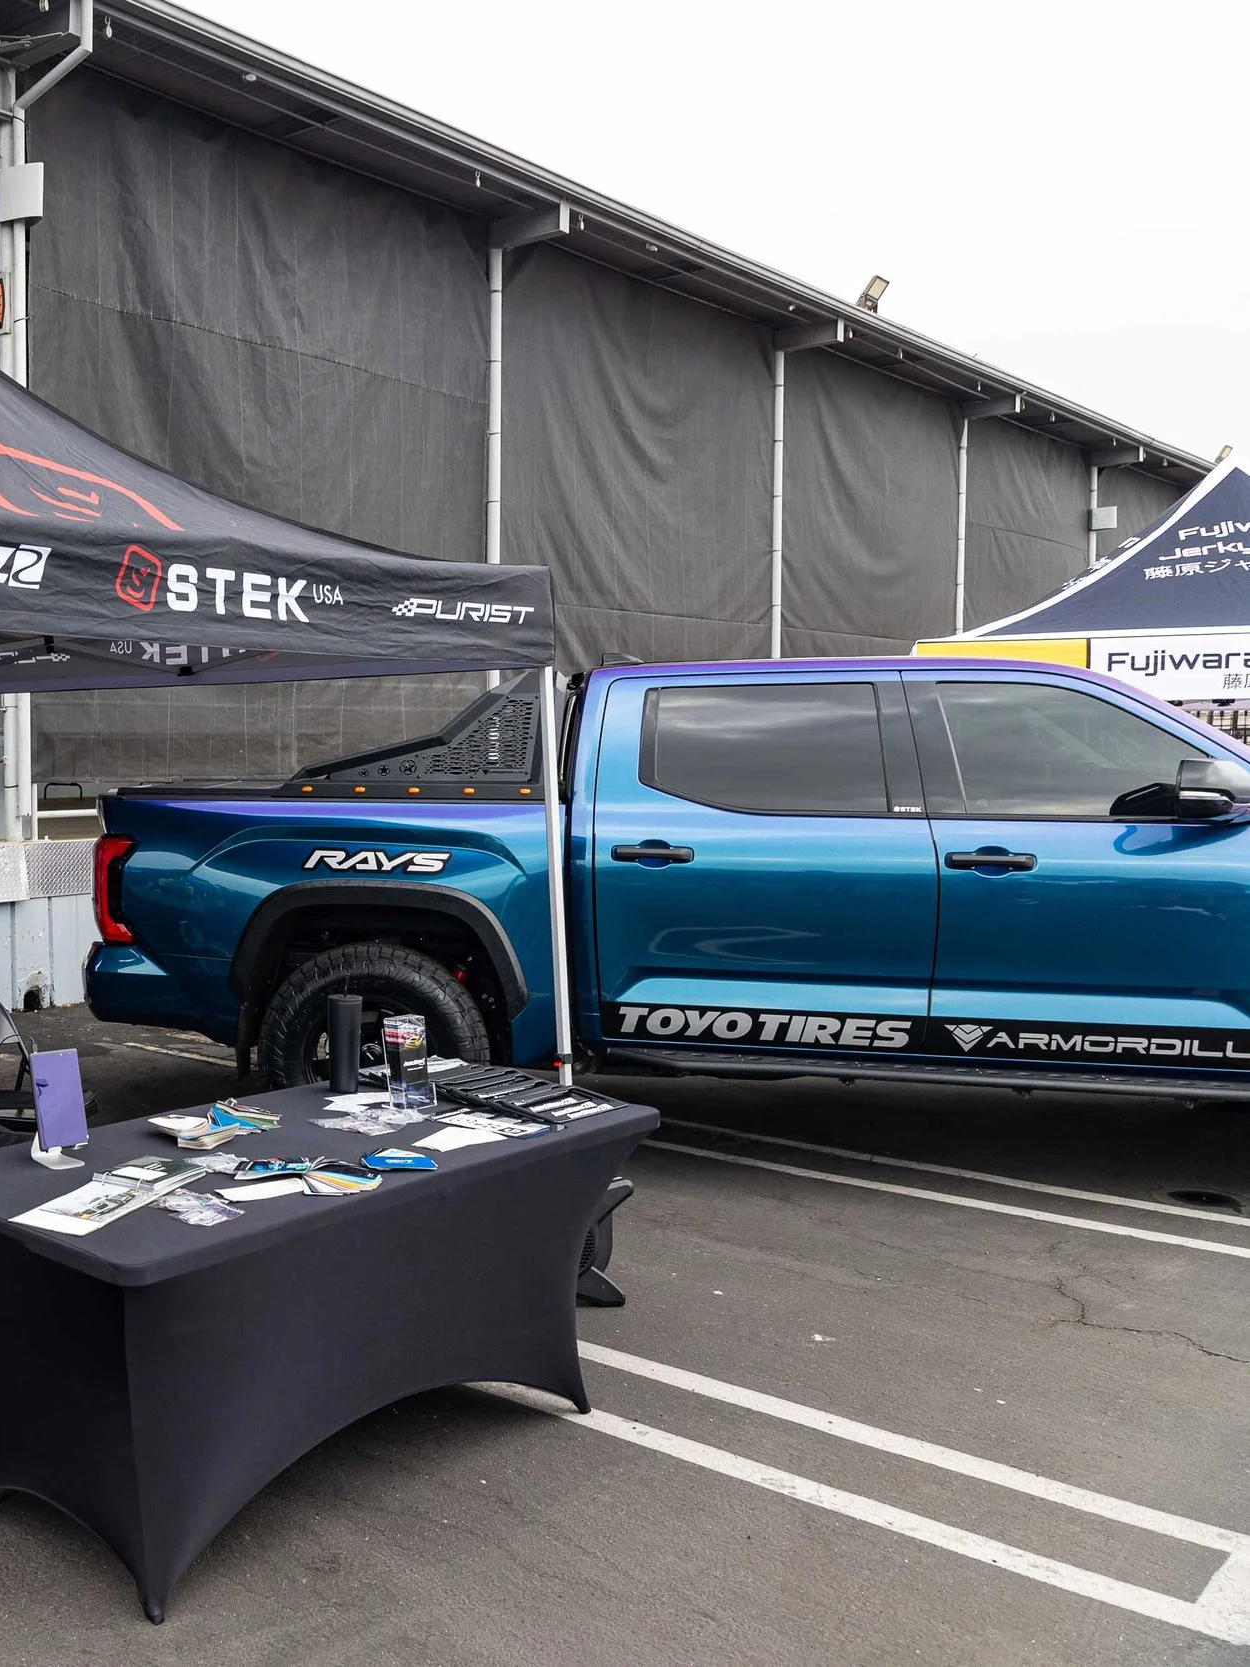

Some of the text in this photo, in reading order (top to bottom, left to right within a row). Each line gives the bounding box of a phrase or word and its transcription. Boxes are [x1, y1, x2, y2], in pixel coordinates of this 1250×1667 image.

[166, 563, 344, 623] STEK USA
[405, 597, 535, 625] PURIST
[1223, 673, 1250, 689] 藤
[304, 849, 450, 873] RAYS
[618, 1006, 912, 1047] TOYO TIRES
[986, 1031, 1250, 1059] ARMORDILL
